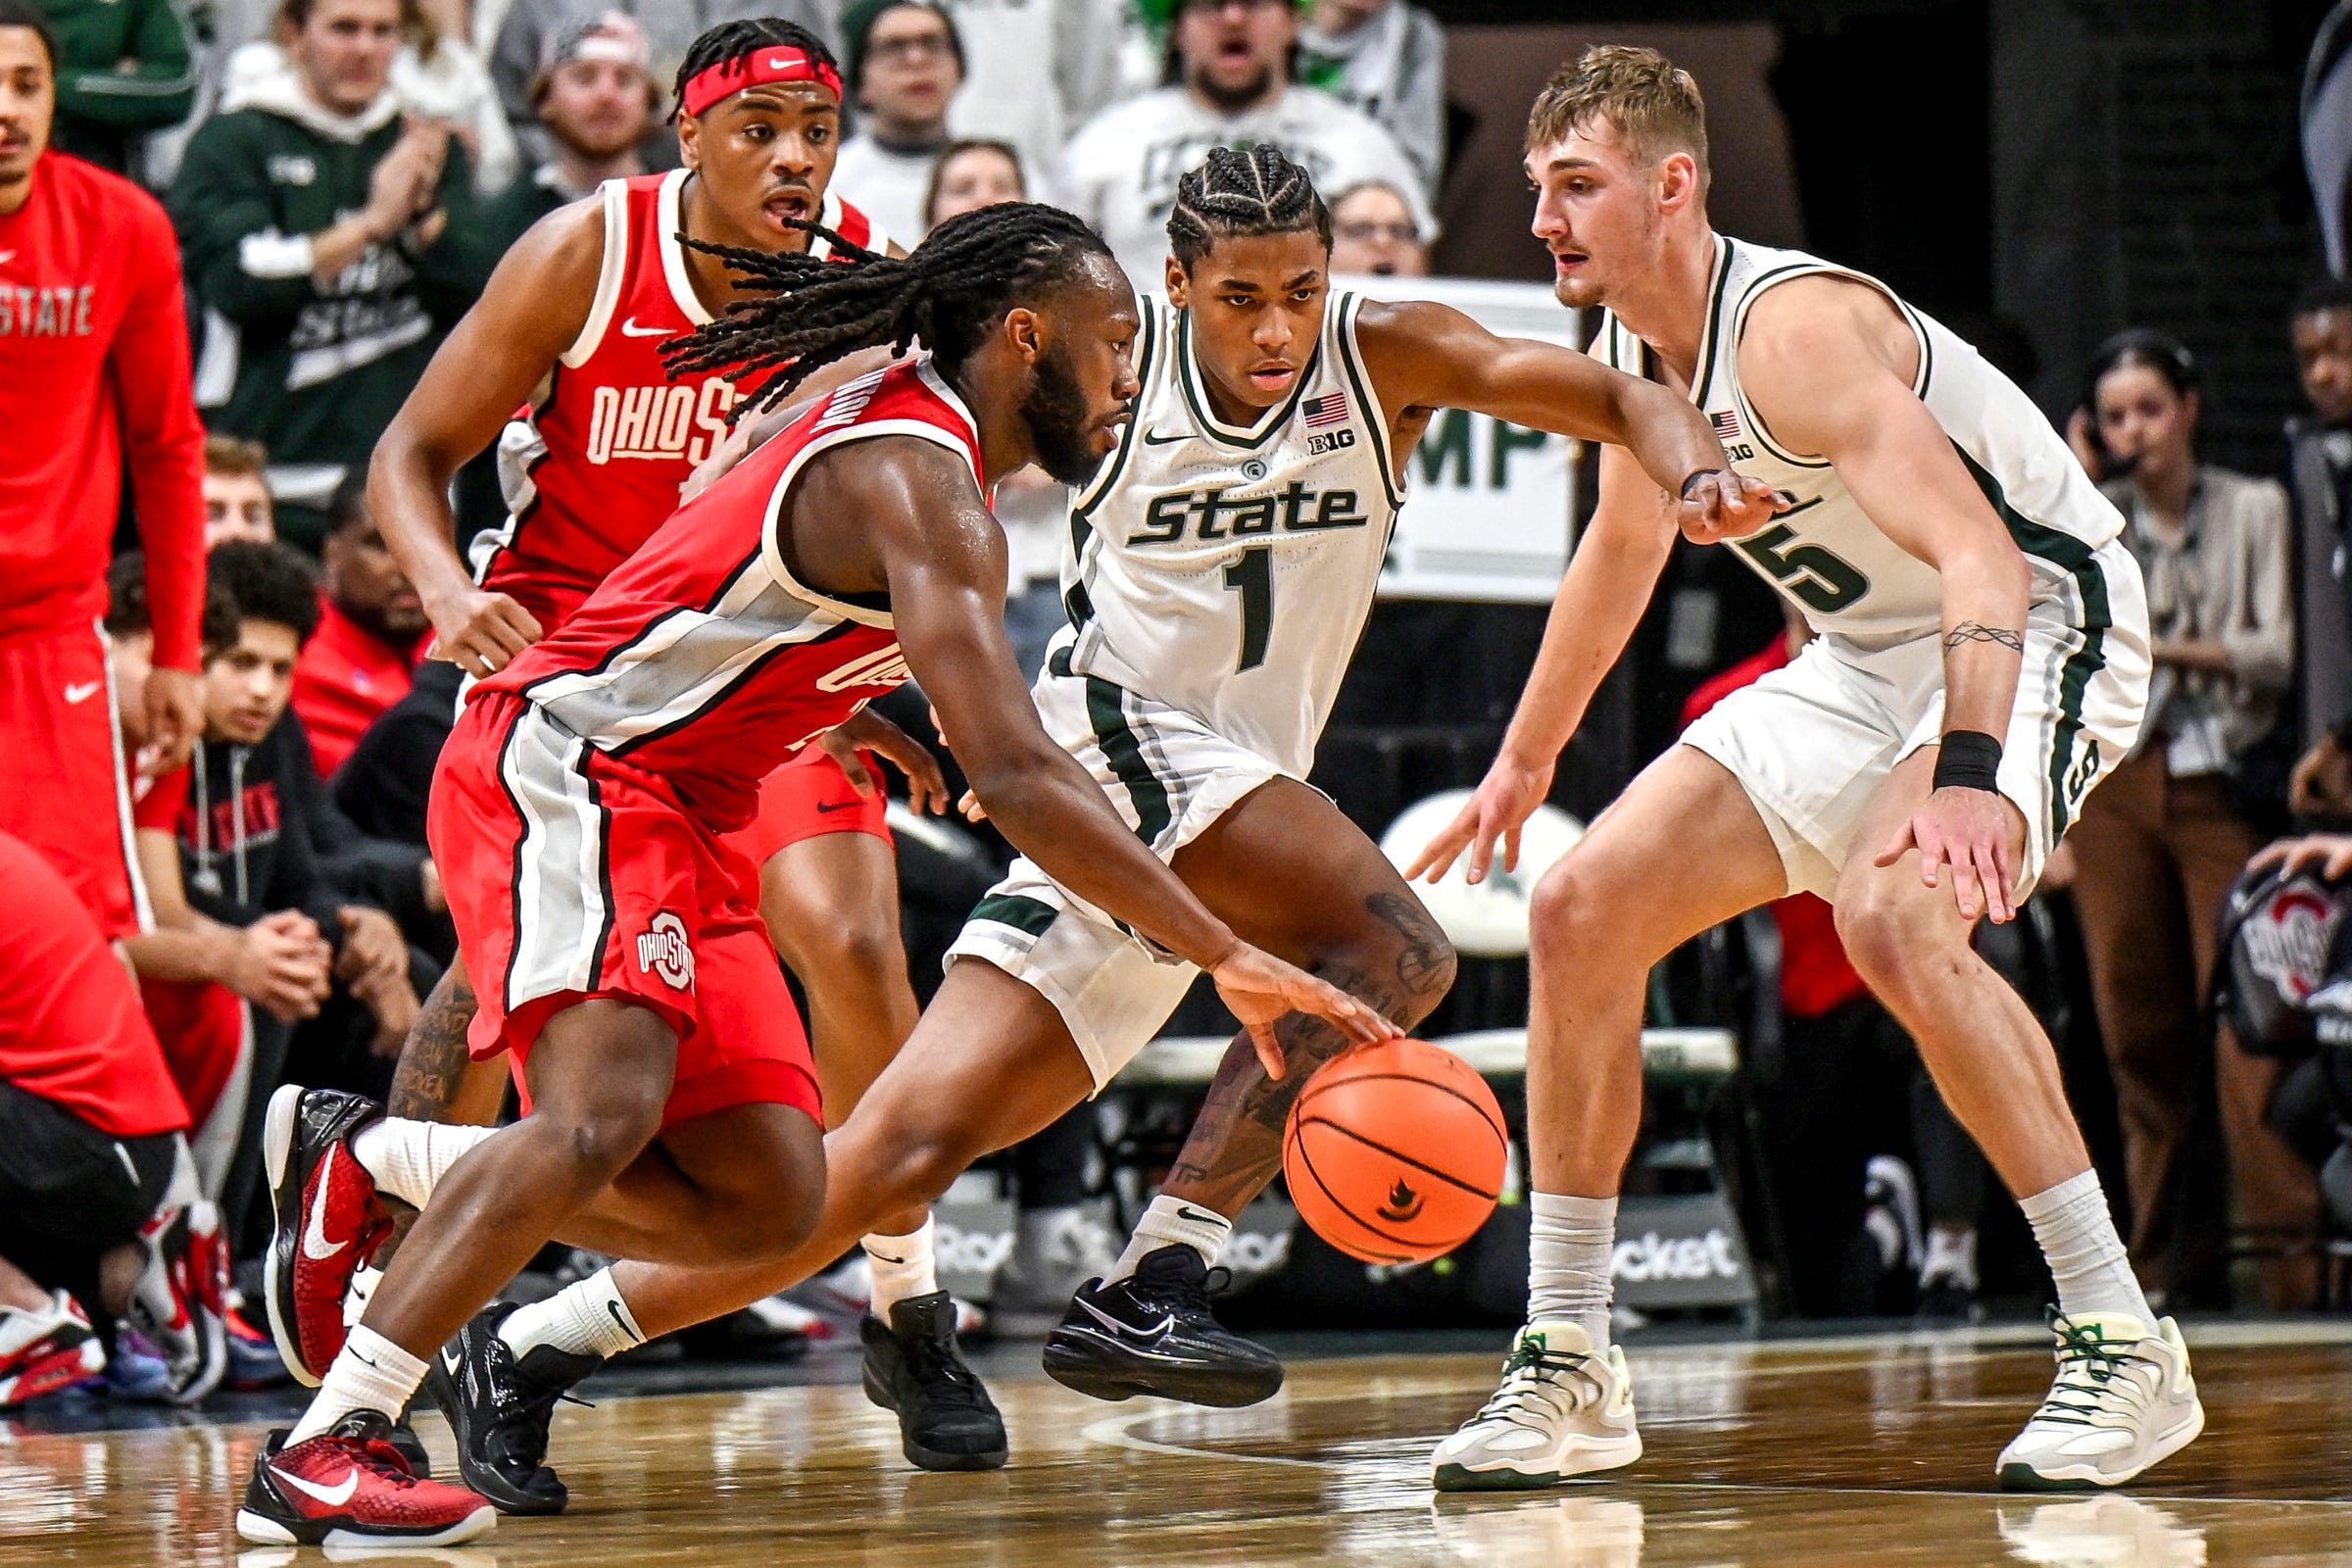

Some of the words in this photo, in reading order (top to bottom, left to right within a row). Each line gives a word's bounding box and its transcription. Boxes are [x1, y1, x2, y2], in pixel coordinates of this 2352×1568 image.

[1417, 407, 1548, 489] MP
[1125, 480, 1369, 548] State
[1222, 544, 1275, 675] 1
[1734, 522, 1871, 615] 5
[1611, 1228, 1740, 1282] cket
